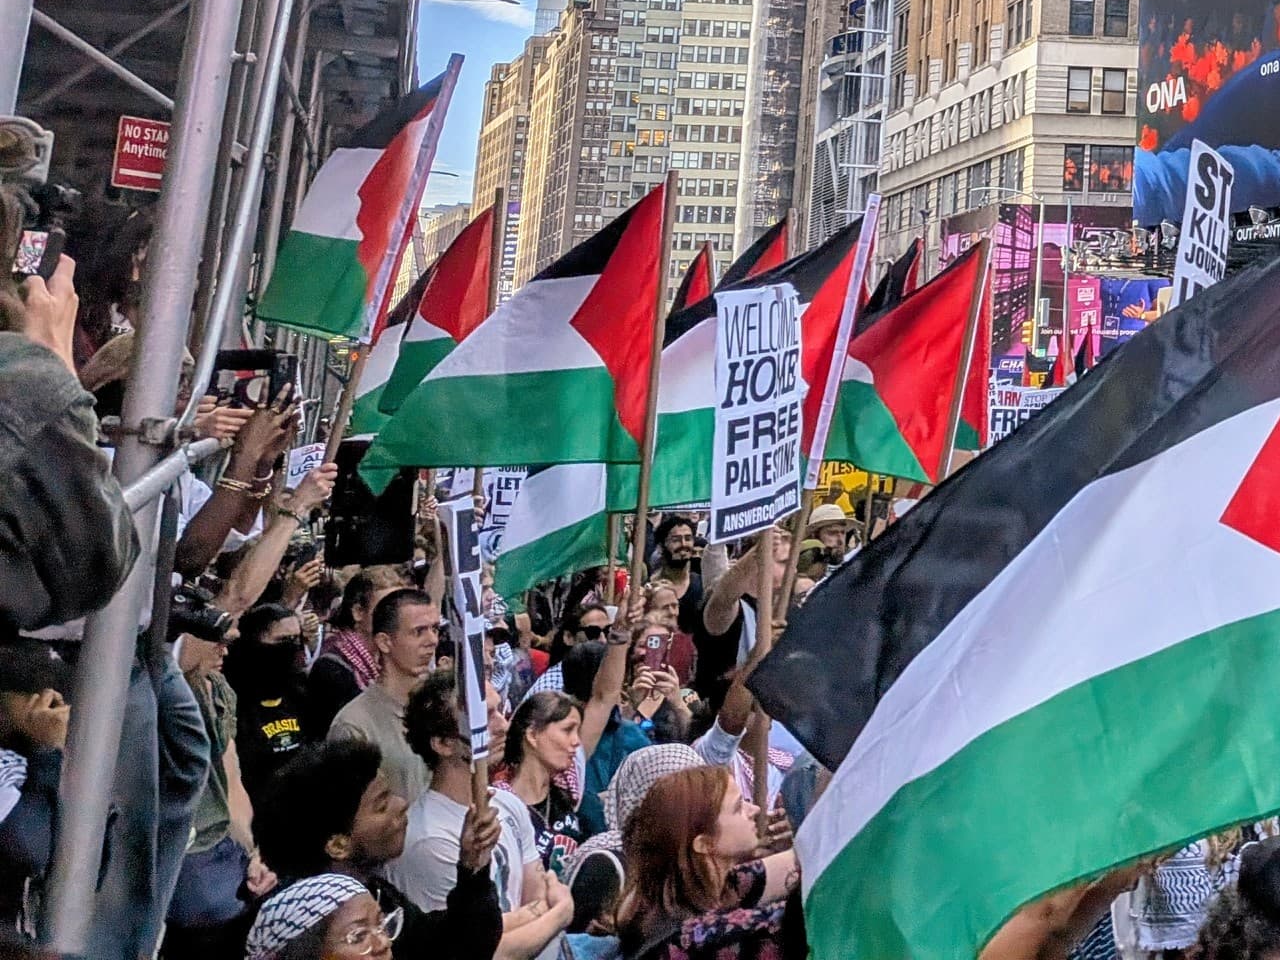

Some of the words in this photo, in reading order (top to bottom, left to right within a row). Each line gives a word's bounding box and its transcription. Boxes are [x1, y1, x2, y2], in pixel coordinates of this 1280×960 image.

[1146, 76, 1187, 114] ONA
[124, 124, 141, 139] NO
[721, 348, 799, 409] HOME
[726, 401, 799, 456] FREE
[497, 477, 522, 490] LET
[725, 441, 796, 496] PALESTINE
[261, 718, 300, 739] BRASIL
